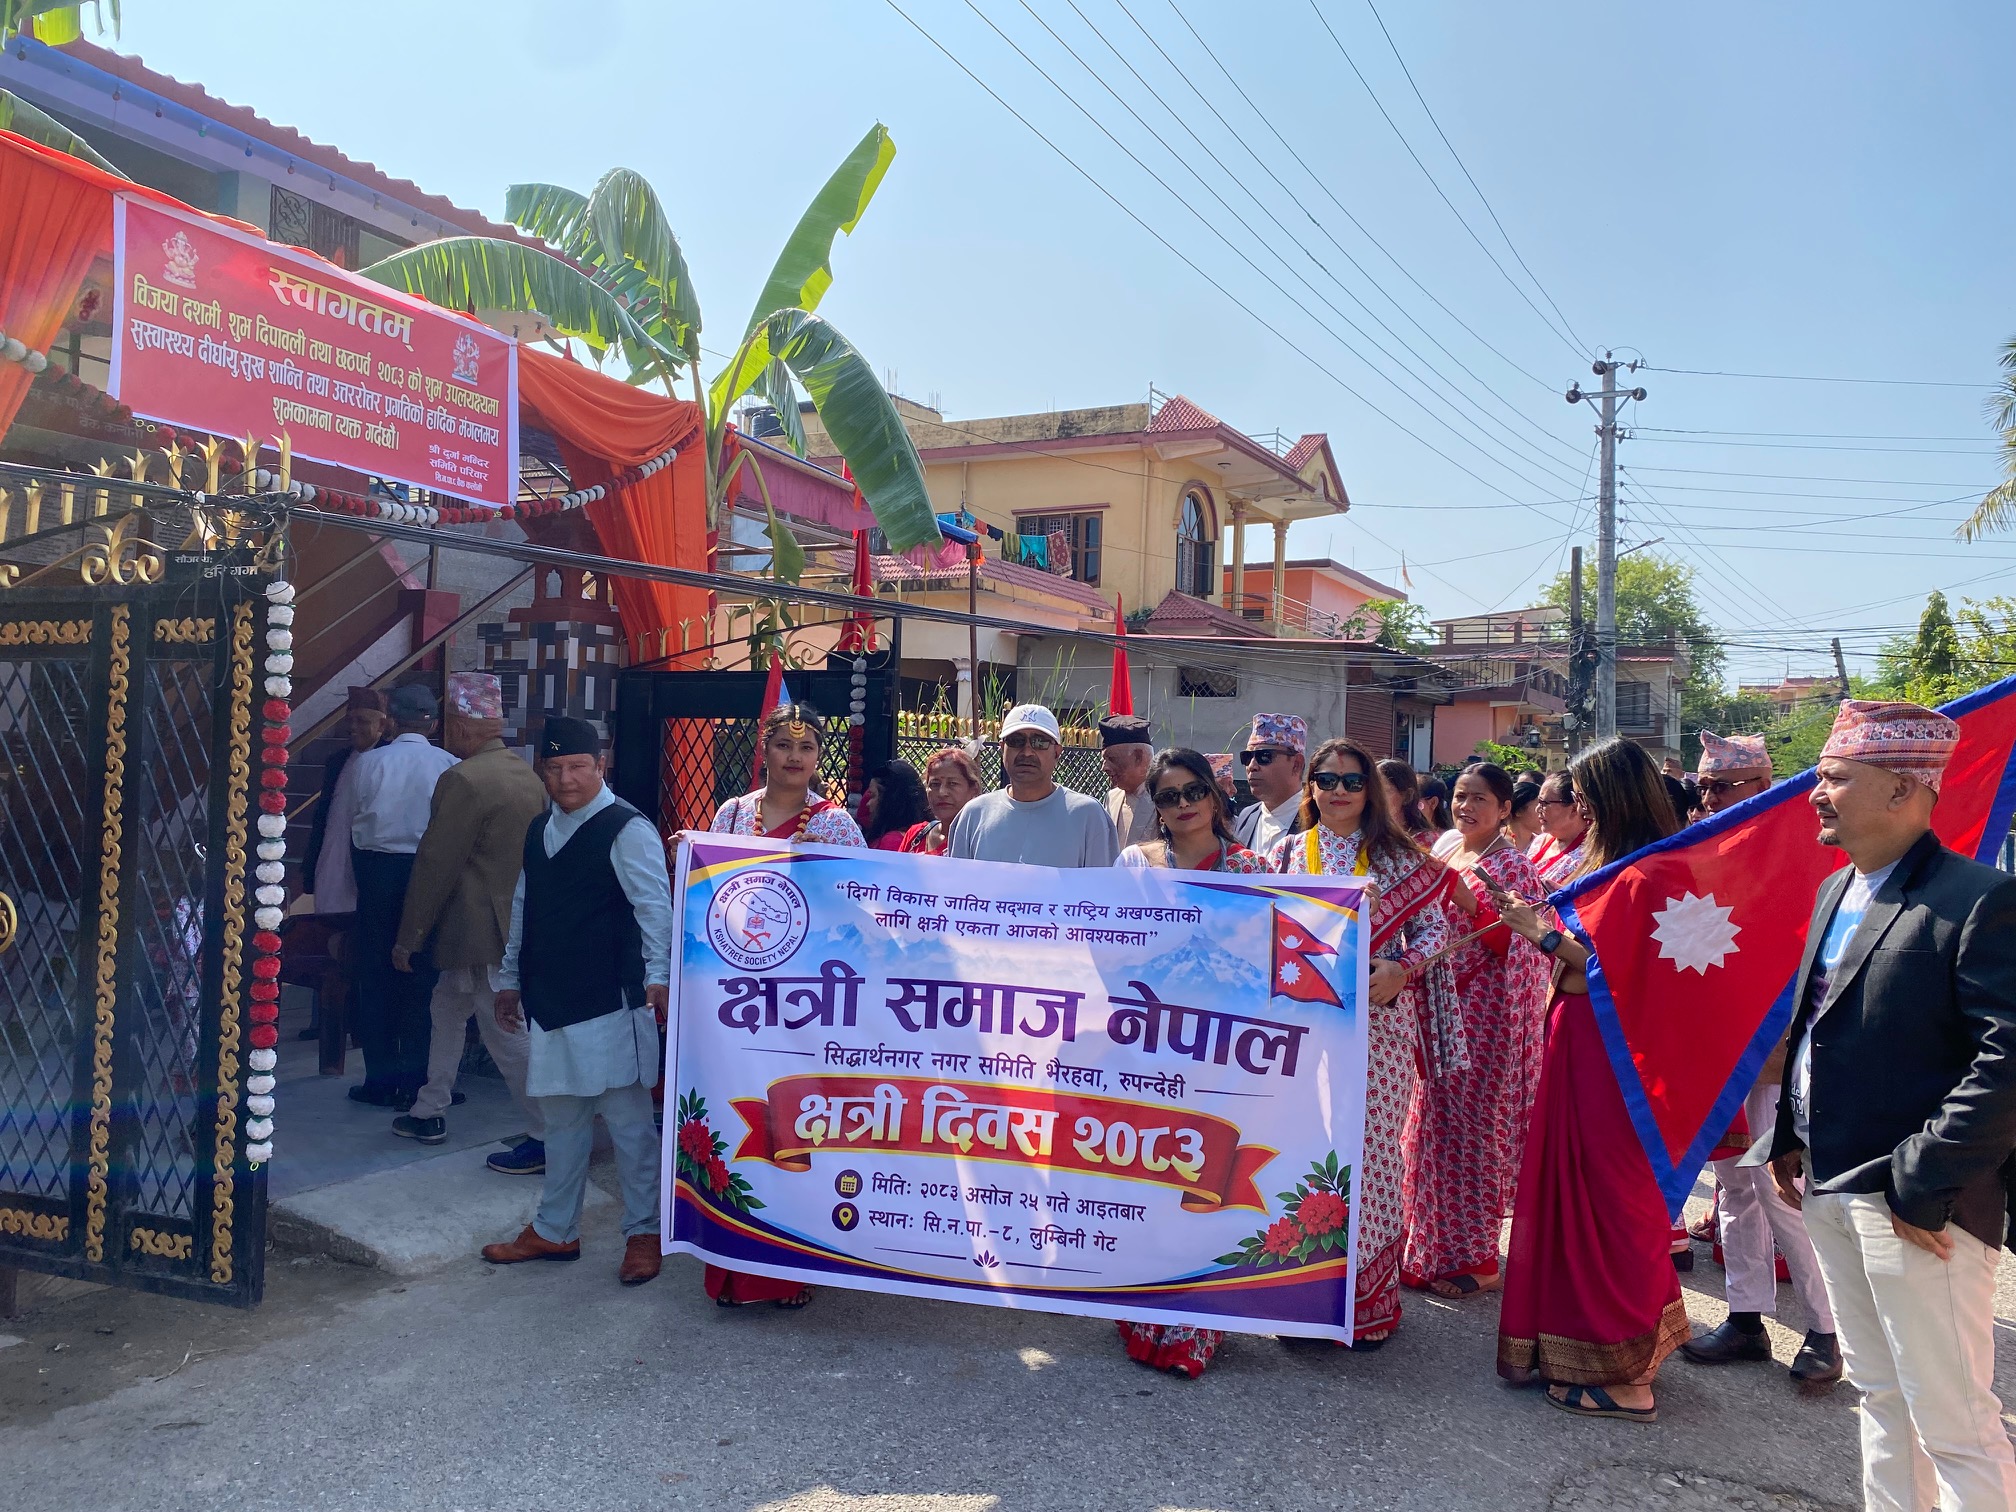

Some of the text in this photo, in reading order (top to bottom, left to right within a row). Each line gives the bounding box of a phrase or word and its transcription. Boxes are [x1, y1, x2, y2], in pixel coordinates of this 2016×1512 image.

[268, 266, 414, 352] स्वागतम्
[133, 273, 179, 316] विजया
[182, 299, 223, 332] दशमी,
[228, 311, 252, 343] शुभ
[256, 314, 306, 357] दिपावली
[309, 338, 333, 365] तथा
[377, 361, 404, 389] २०८३
[408, 367, 422, 392] को
[425, 376, 443, 402] शुभ
[268, 358, 304, 390] शान्ति
[306, 371, 330, 398] तथा
[385, 394, 424, 425] प्रगतिको
[426, 405, 456, 434] हार्दिक
[458, 416, 500, 447] मंगलमय
[272, 396, 333, 433] शुभकामना
[335, 414, 363, 439] व्यक्त
[429, 444, 440, 454] श्री
[429, 459, 488, 481] समिति परिवार
[719, 875, 802, 909] क्षत्री समाज नेपाल
[887, 885, 938, 908] विकास
[944, 893, 991, 913] जातिय
[996, 900, 1043, 918] सद्भाव
[1048, 904, 1058, 917] र
[1063, 900, 1110, 922] राष्ट्रिय
[1115, 905, 1202, 925] अखण्डताको
[875, 909, 911, 929] लागि
[917, 914, 949, 933] क्षत्री
[955, 920, 1000, 937] एकता
[1006, 922, 1059, 941] आजको
[713, 928, 799, 966] KSHATREE SOCIETY NEPAL
[717, 959, 1310, 1078] क्षत्री समाज नेपाल
[824, 1041, 1186, 1099] सिद्धार्थनगर नगर समिति भैरहवा, रुपन्देही
[794, 1083, 1207, 1183] क्षत्री दिवस २०८३
[920, 1182, 959, 1202] २०८३
[965, 1183, 1013, 1207] असोज
[1019, 1192, 1038, 1212] २५
[1045, 1191, 1070, 1214] गते
[1074, 1197, 1147, 1223] आइतबार
[1029, 1222, 1087, 1251] लुम्बिनी
[1092, 1229, 1118, 1253] गेट
